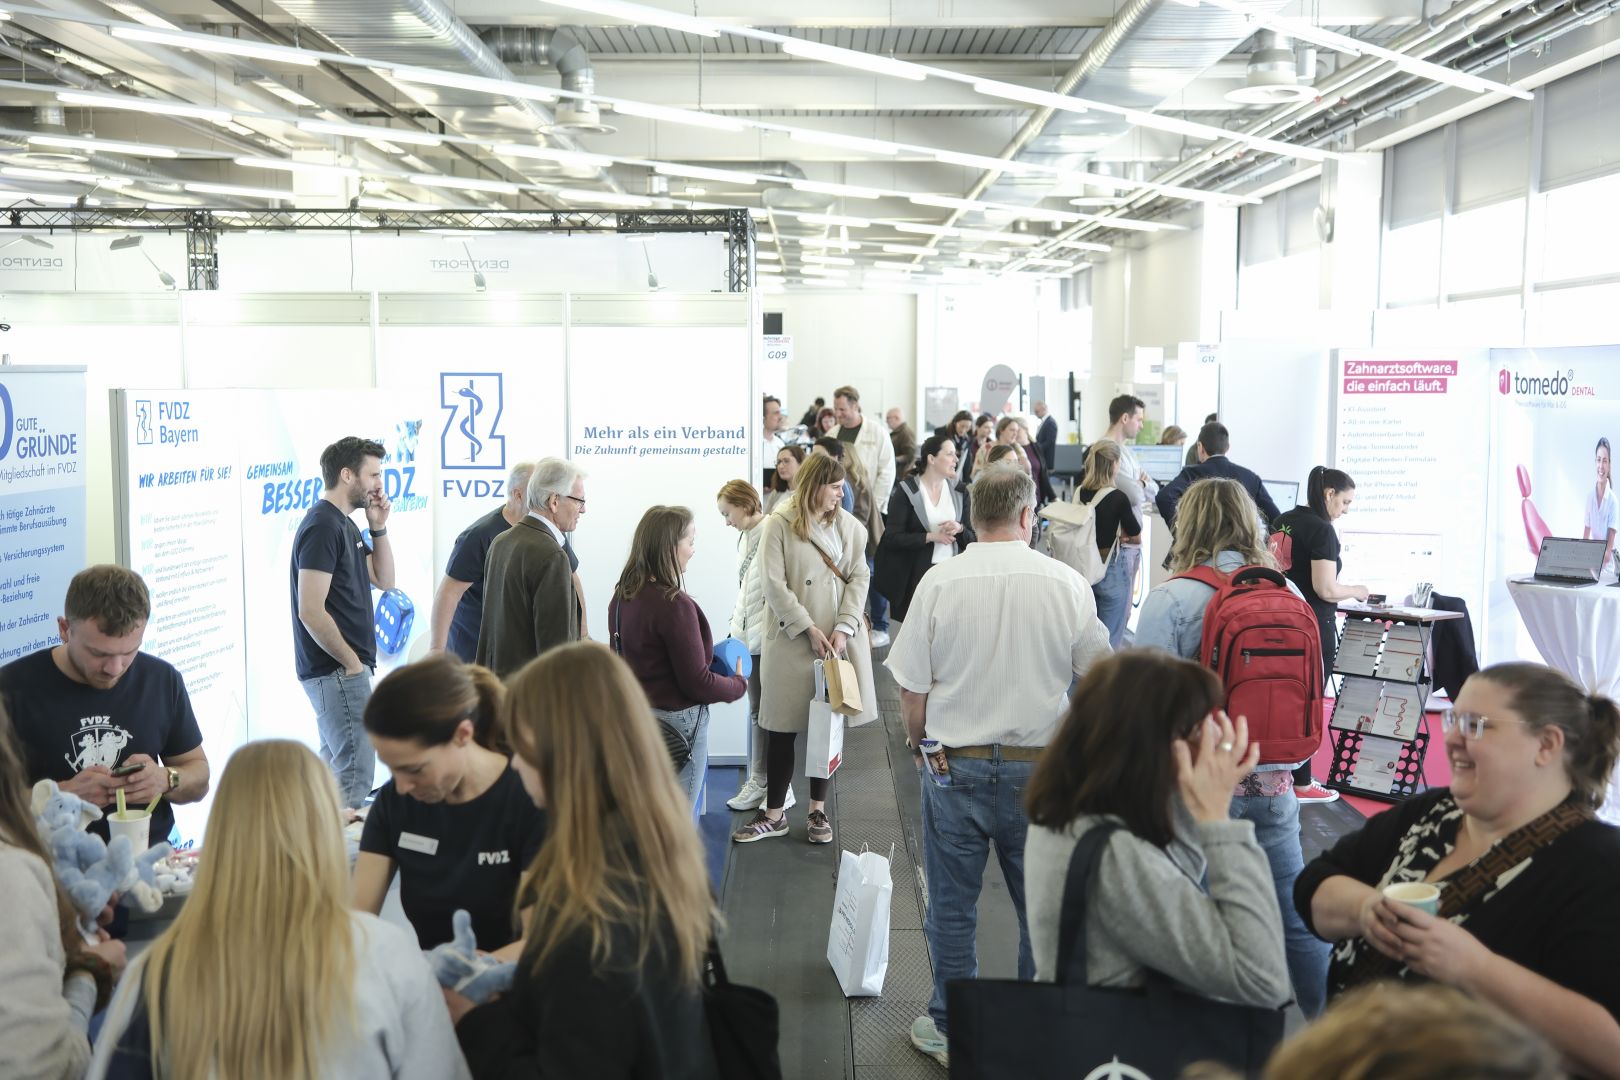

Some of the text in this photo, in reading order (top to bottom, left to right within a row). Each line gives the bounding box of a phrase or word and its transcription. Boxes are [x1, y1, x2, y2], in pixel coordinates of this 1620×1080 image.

[768, 350, 787, 359] G09
[1347, 362, 1455, 375] Zahnarztsoftware,
[1346, 379, 1444, 392] die einfach läuft.
[1571, 386, 1595, 396] DENTAL
[158, 401, 190, 420] FVDZ
[16, 418, 38, 431] GUTE
[159, 425, 199, 448] Bayern
[583, 426, 745, 439] Mehr als ein Verband
[16, 429, 77, 459] GRÜNDE
[574, 445, 592, 455] Die
[594, 445, 637, 456] Zukunft
[639, 445, 701, 457] gemeinsam
[47, 464, 55, 476] im
[57, 462, 77, 475] FVDZ
[138, 464, 232, 489] WIR ARBEITEN FÜR SIE!
[246, 461, 293, 480] GEMEINSAM
[380, 466, 416, 502] DZ
[442, 479, 505, 498] FVDZ
[262, 477, 323, 515] BESSER
[392, 495, 429, 513] BAYERN
[6, 509, 23, 520] tätige
[24, 505, 55, 517] Zahnärzte
[19, 517, 67, 531] Berufsausübung
[3, 544, 65, 561] Versicherungssystem
[13, 576, 25, 588] und
[26, 573, 40, 584] freie
[7, 619, 17, 630] der
[18, 612, 49, 627] Zahnärzte
[22, 643, 32, 653] mit
[33, 639, 46, 650] dem
[80, 716, 110, 727] FVDZ
